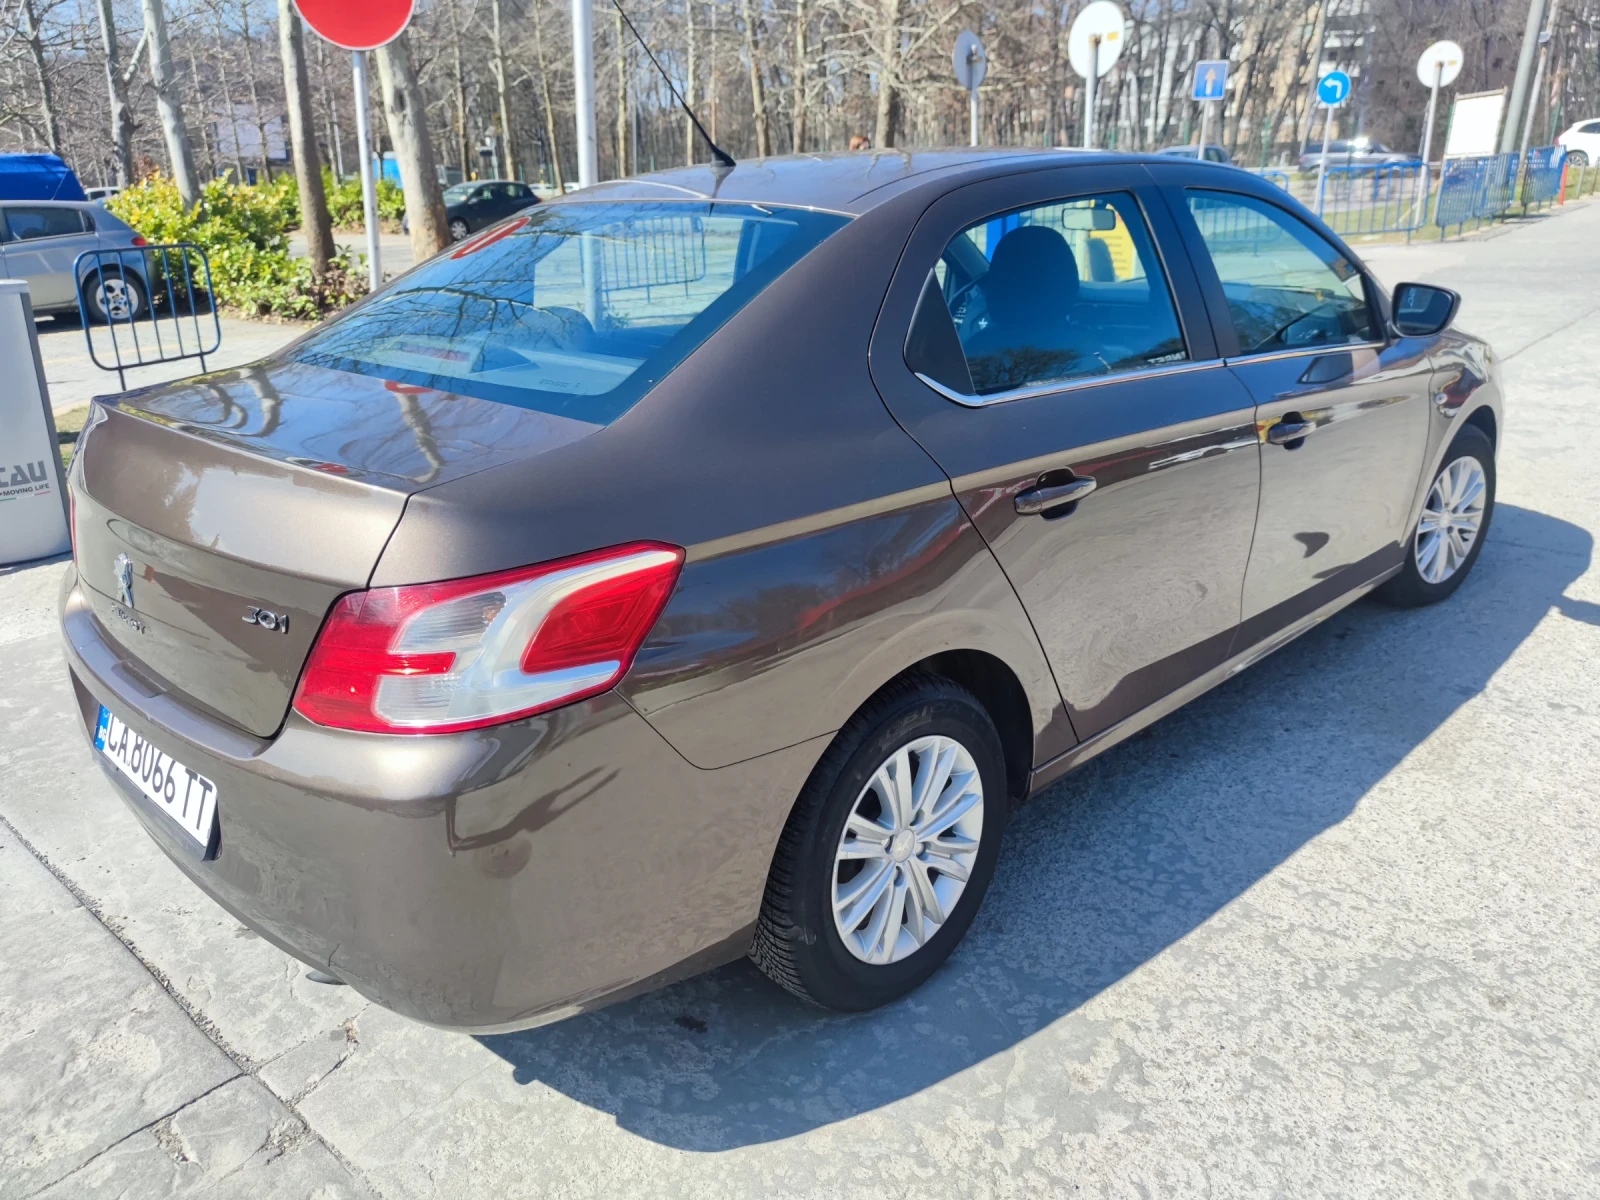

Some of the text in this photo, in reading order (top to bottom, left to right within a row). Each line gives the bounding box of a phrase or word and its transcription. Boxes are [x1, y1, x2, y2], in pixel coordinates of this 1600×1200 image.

[3, 483, 51, 497] MOVING LIFE
[241, 605, 289, 634] 301
[98, 725, 107, 742] BG
[108, 714, 213, 830] CA 8066 TT
